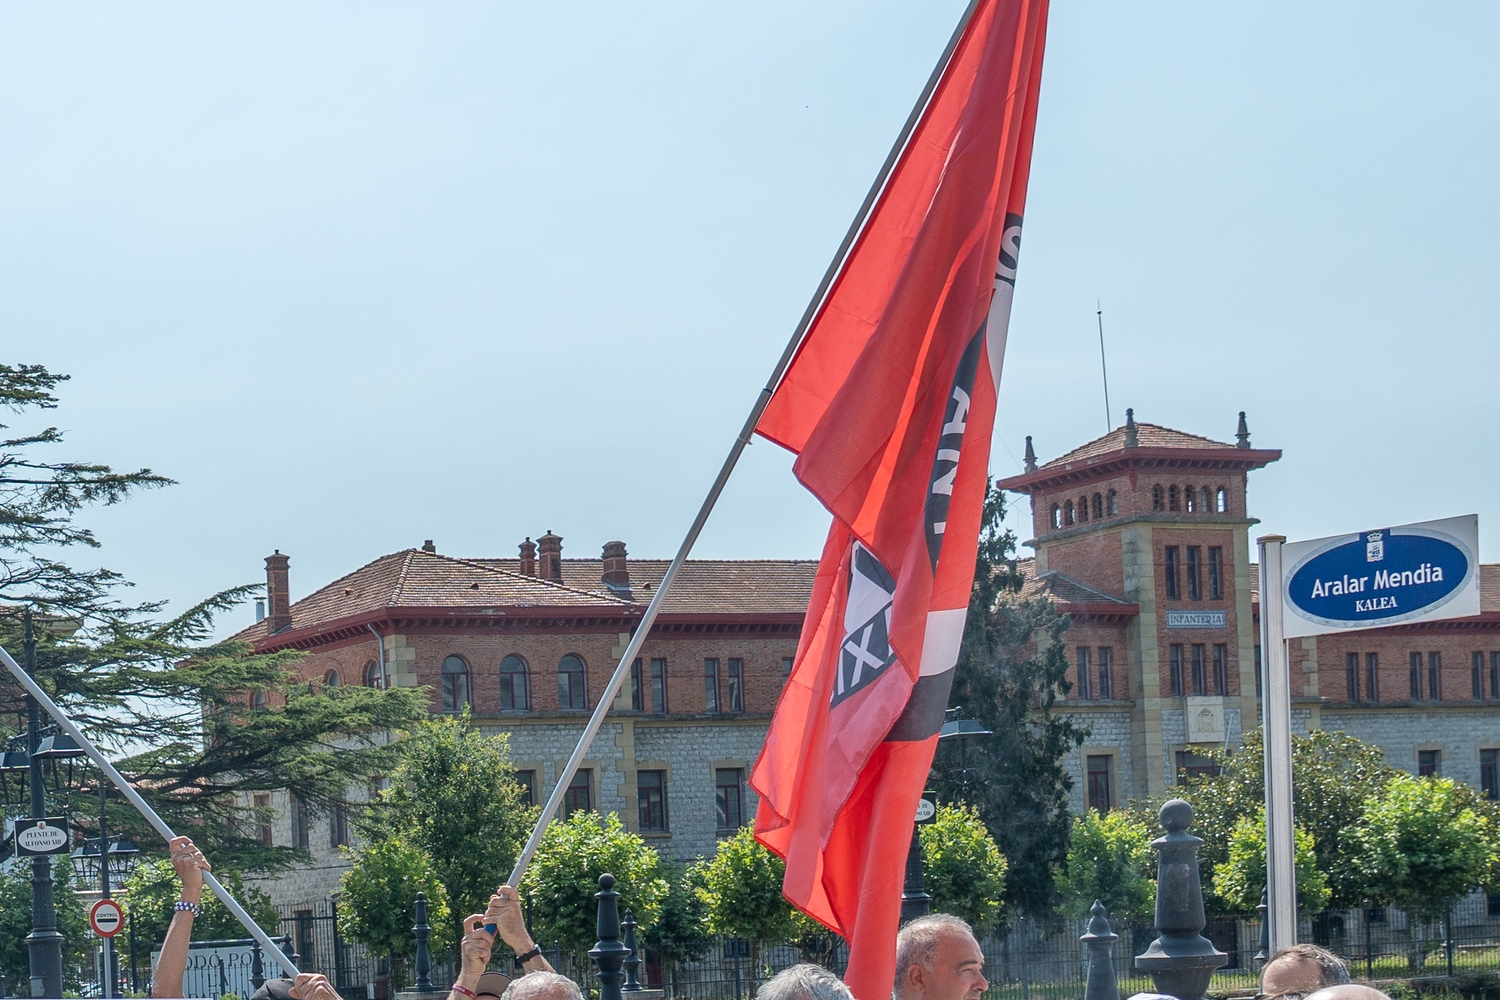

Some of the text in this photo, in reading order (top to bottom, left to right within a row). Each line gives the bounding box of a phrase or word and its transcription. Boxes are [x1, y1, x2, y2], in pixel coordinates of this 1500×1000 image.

[1311, 563, 1443, 599] Aralar Mendia
[1355, 596, 1398, 612] KALEA
